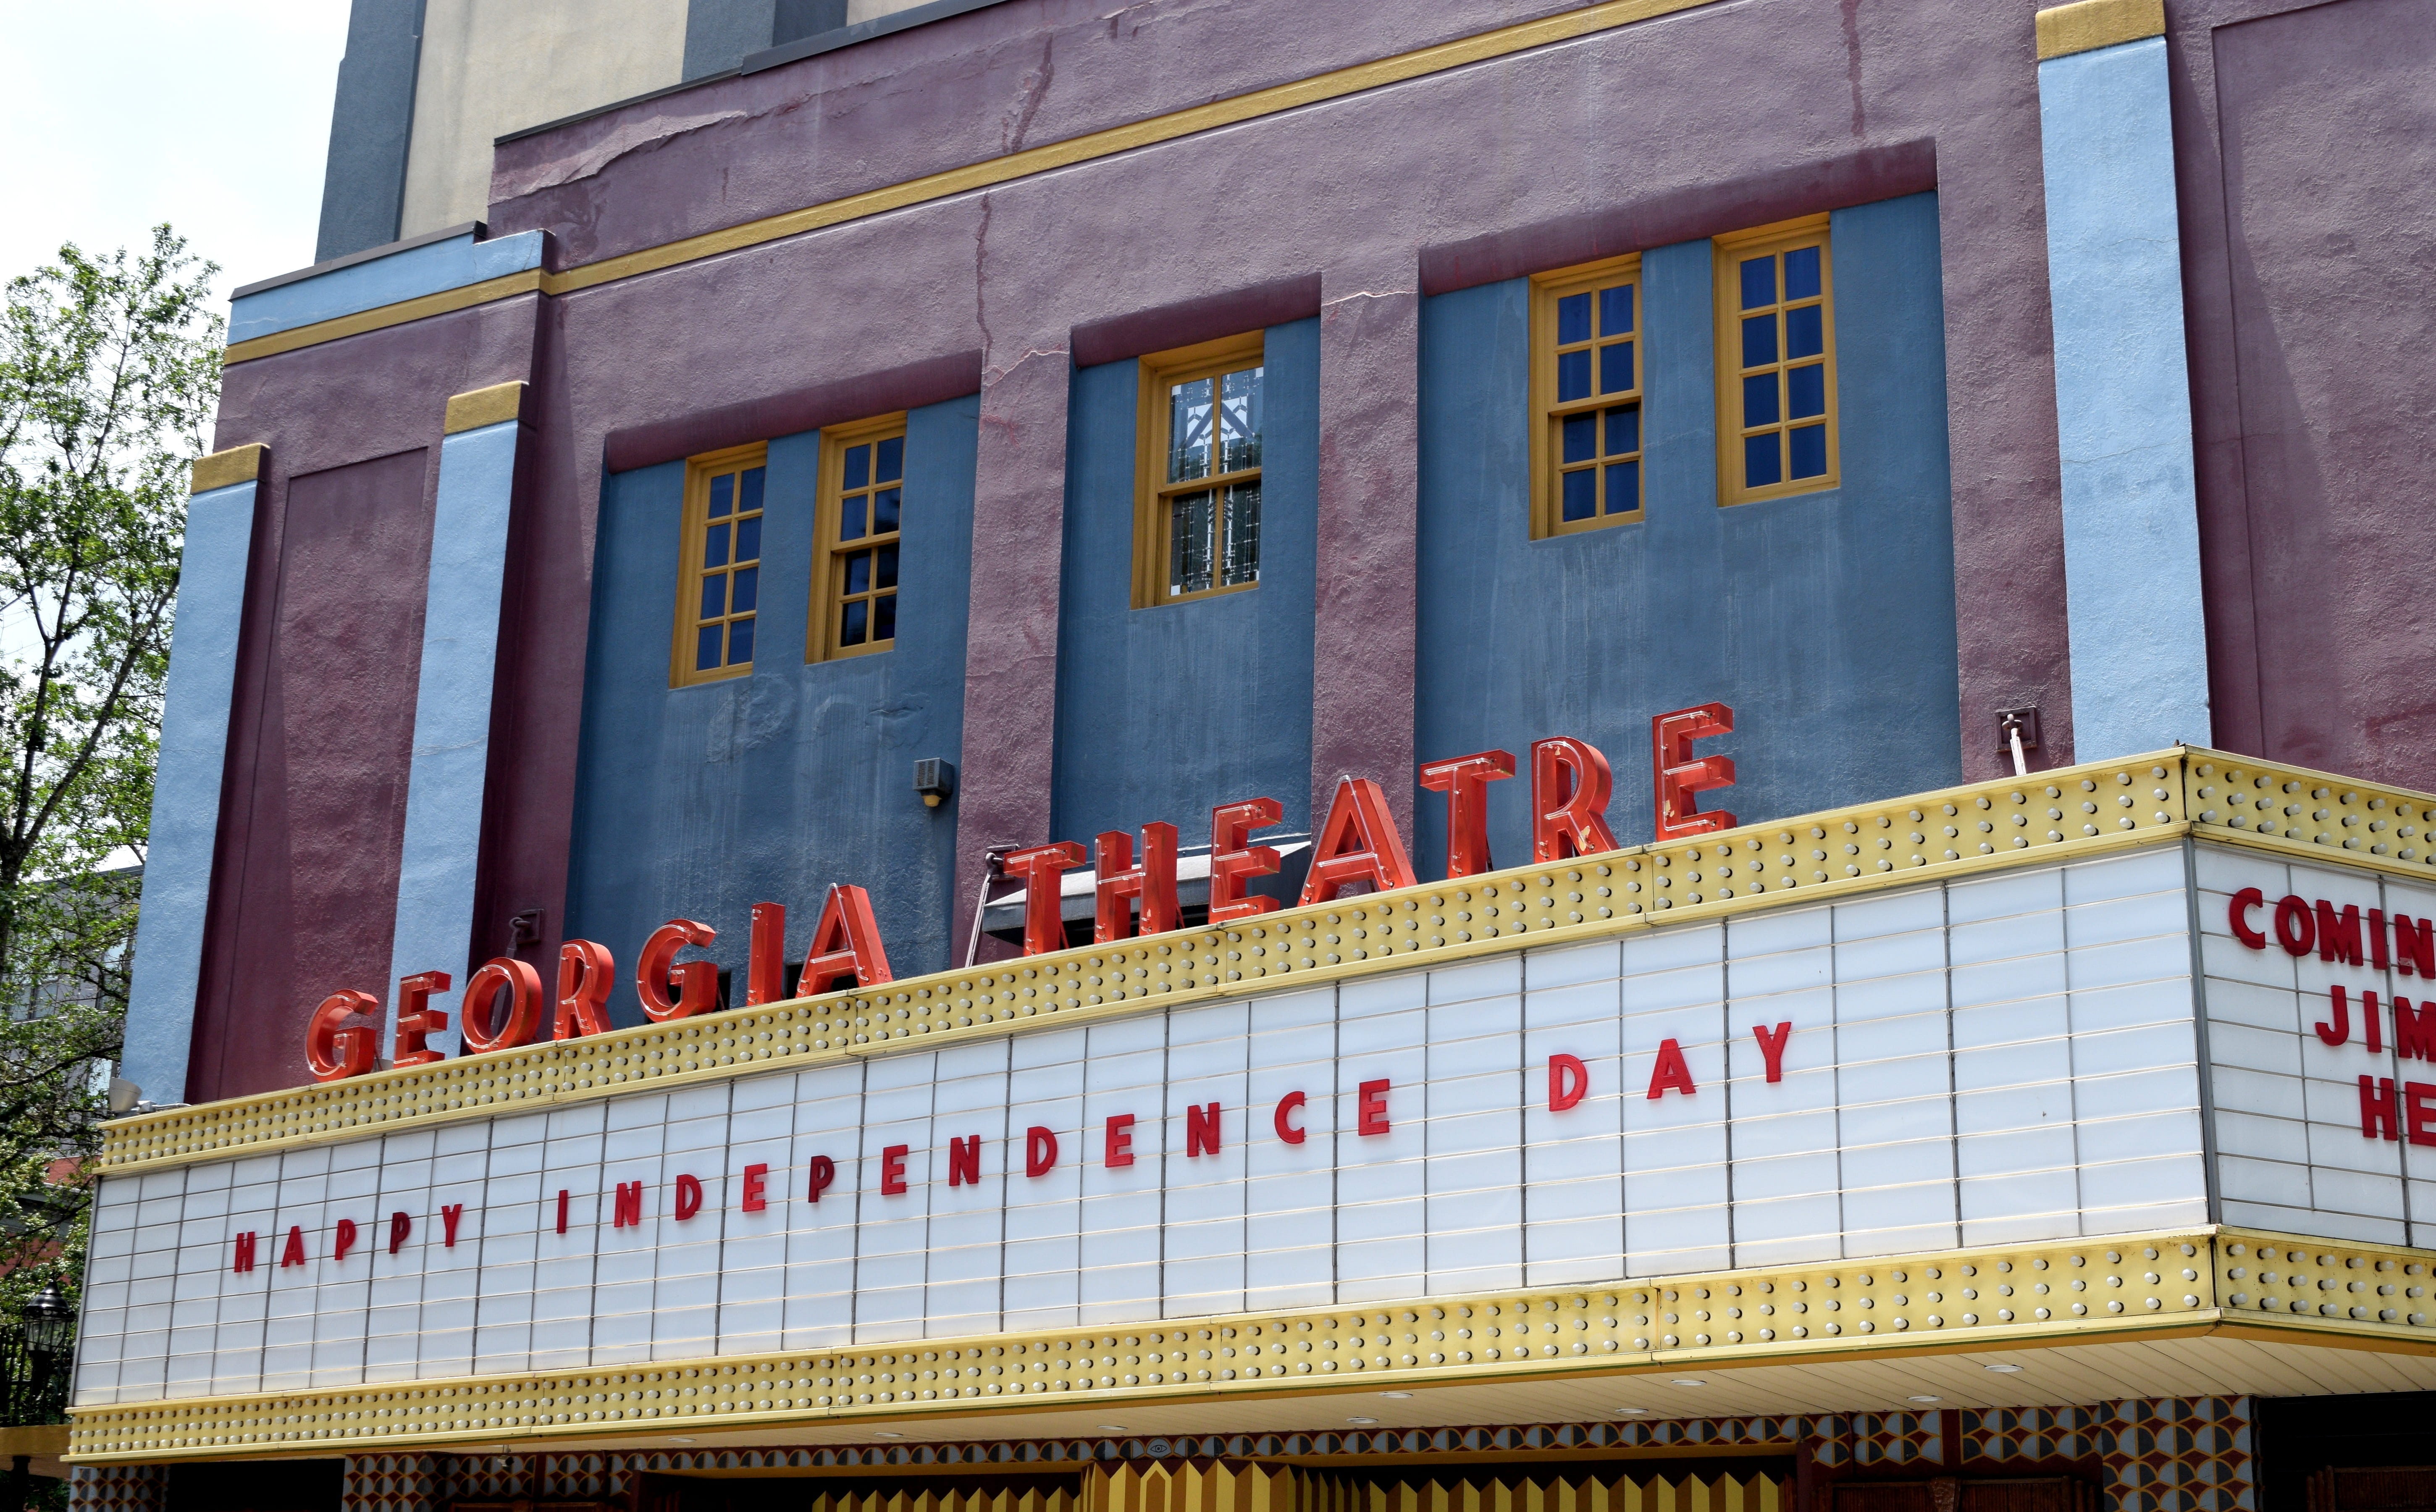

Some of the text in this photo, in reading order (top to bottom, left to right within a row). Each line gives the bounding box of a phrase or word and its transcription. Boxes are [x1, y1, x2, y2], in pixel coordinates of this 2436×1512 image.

[306, 702, 1737, 1083] GEORGIA THEATRE
[2229, 887, 2436, 980] COMIN
[2315, 984, 2436, 1063] JIM
[234, 1022, 1791, 1273] HAPPY INDEPENDENCE DAY
[2358, 1074, 2436, 1147] HE
